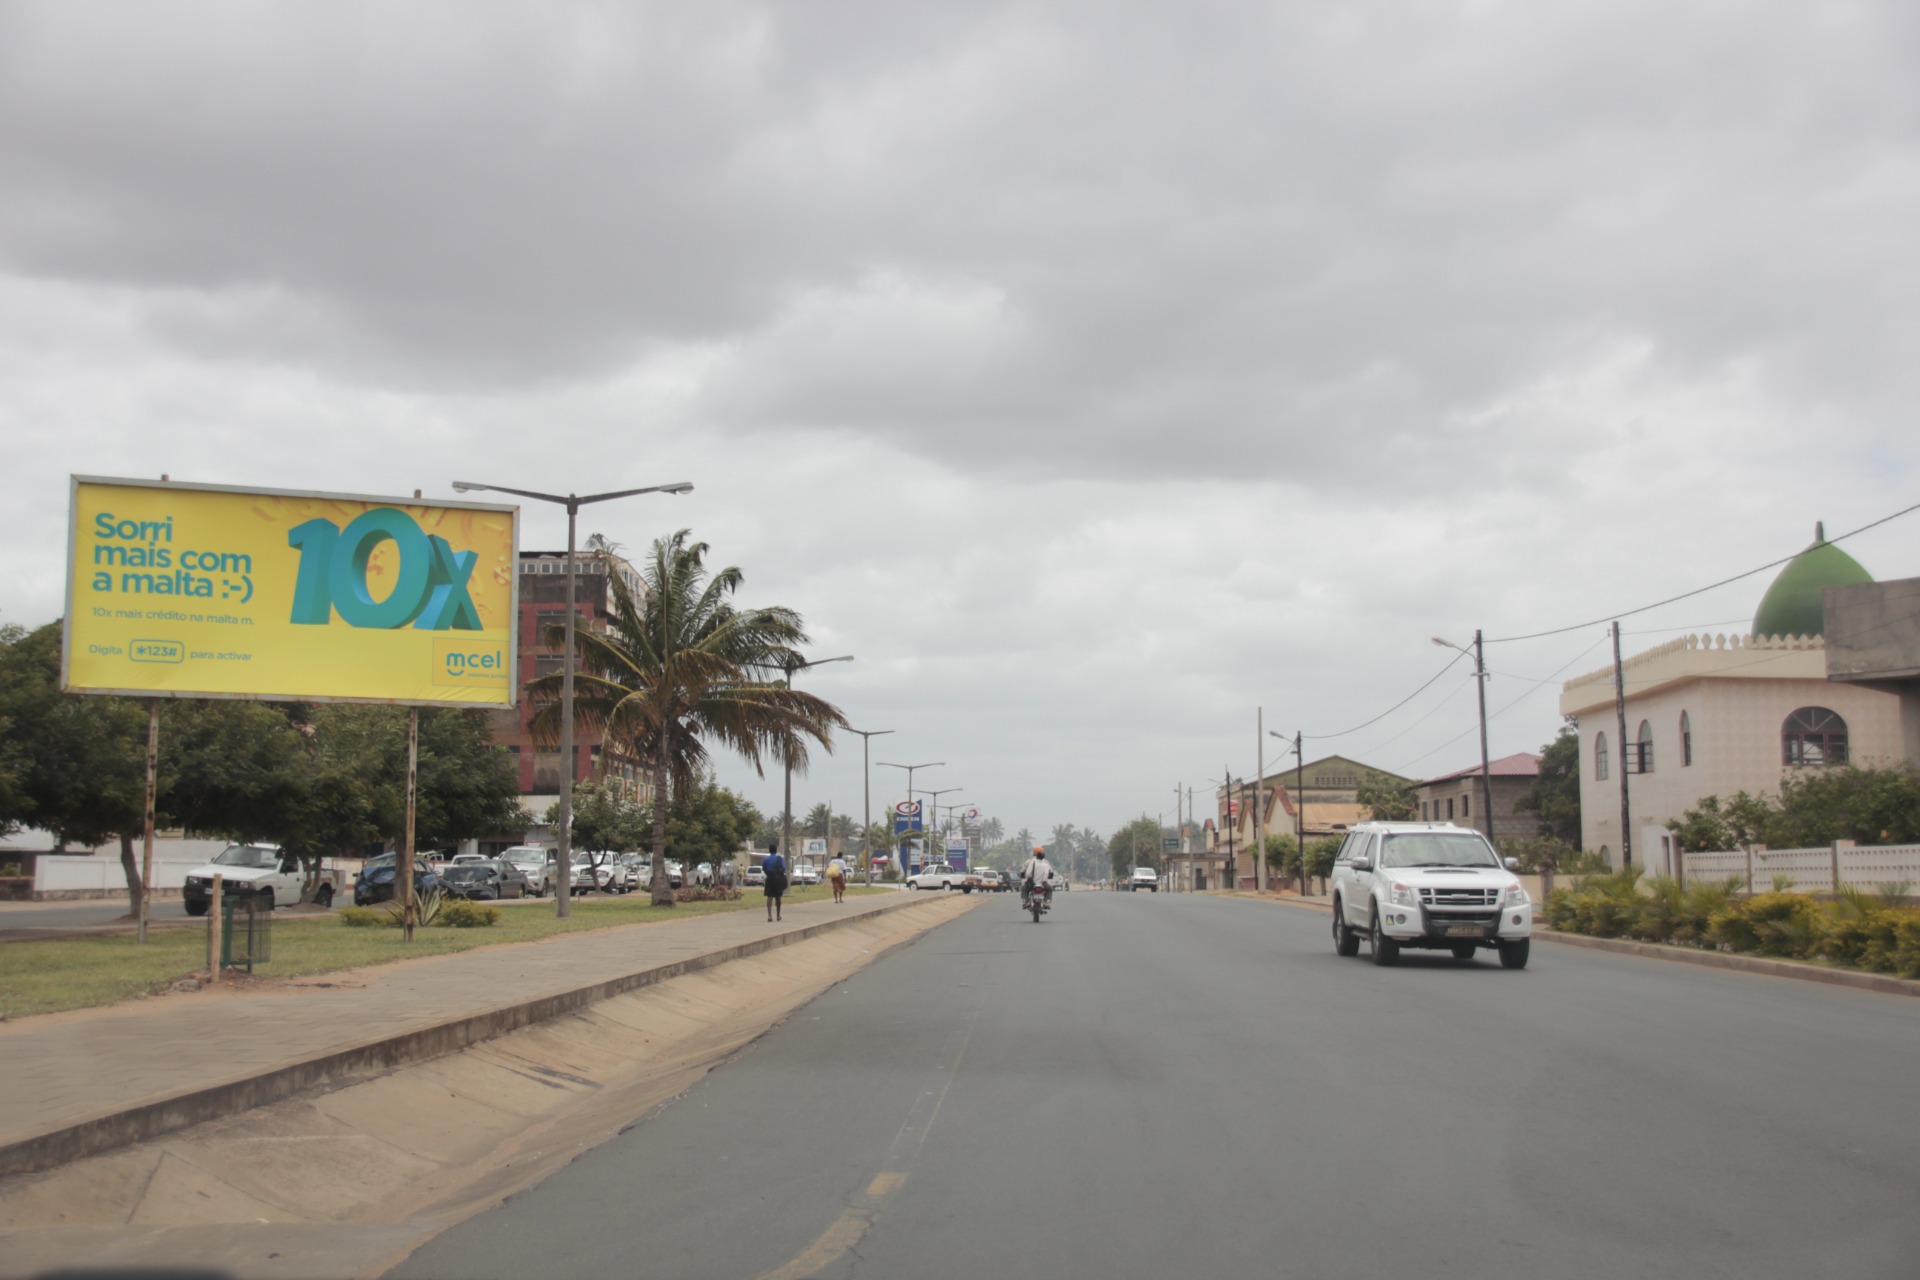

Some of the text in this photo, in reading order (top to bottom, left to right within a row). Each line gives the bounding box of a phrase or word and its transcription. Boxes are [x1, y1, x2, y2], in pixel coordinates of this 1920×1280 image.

[94, 512, 173, 542] Sorri
[94, 541, 252, 574] mais com
[288, 507, 484, 631] 10x
[92, 569, 254, 604] a malta :-)
[92, 607, 112, 617] 10x
[115, 609, 143, 619] mais
[146, 608, 187, 621] crédito
[190, 613, 204, 622] na
[206, 614, 238, 625] malta
[89, 644, 123, 656] Digita
[190, 650, 215, 660] para
[216, 650, 253, 661] activar
[446, 650, 501, 669] mcel
